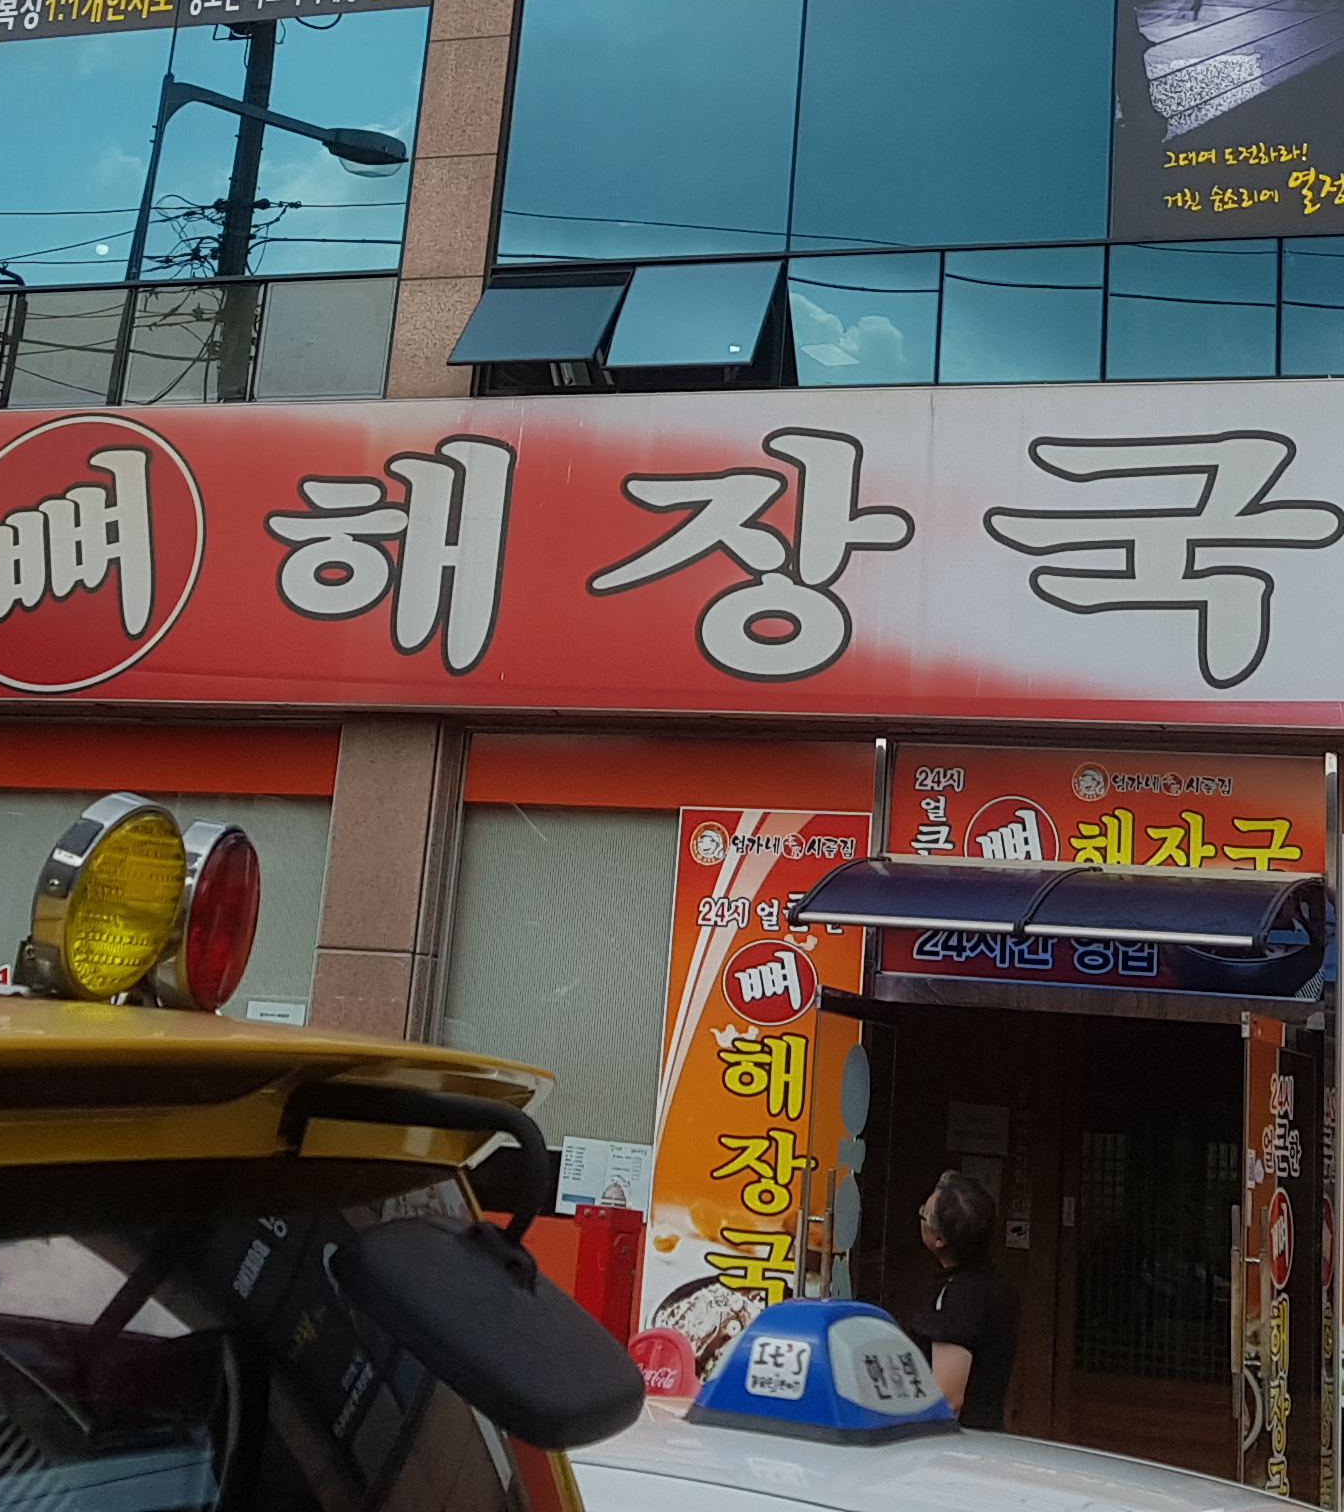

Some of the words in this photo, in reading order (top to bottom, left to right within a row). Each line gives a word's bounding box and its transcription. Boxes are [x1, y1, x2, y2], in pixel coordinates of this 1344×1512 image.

[1163, 148, 1218, 169] 그대여
[1224, 141, 1310, 166] 도전하라!
[1162, 189, 1202, 211] 거친
[1209, 184, 1280, 212] 숨소리에
[913, 767, 965, 793] 24시
[697, 895, 753, 928] 24시
[733, 950, 804, 1012] 뼈
